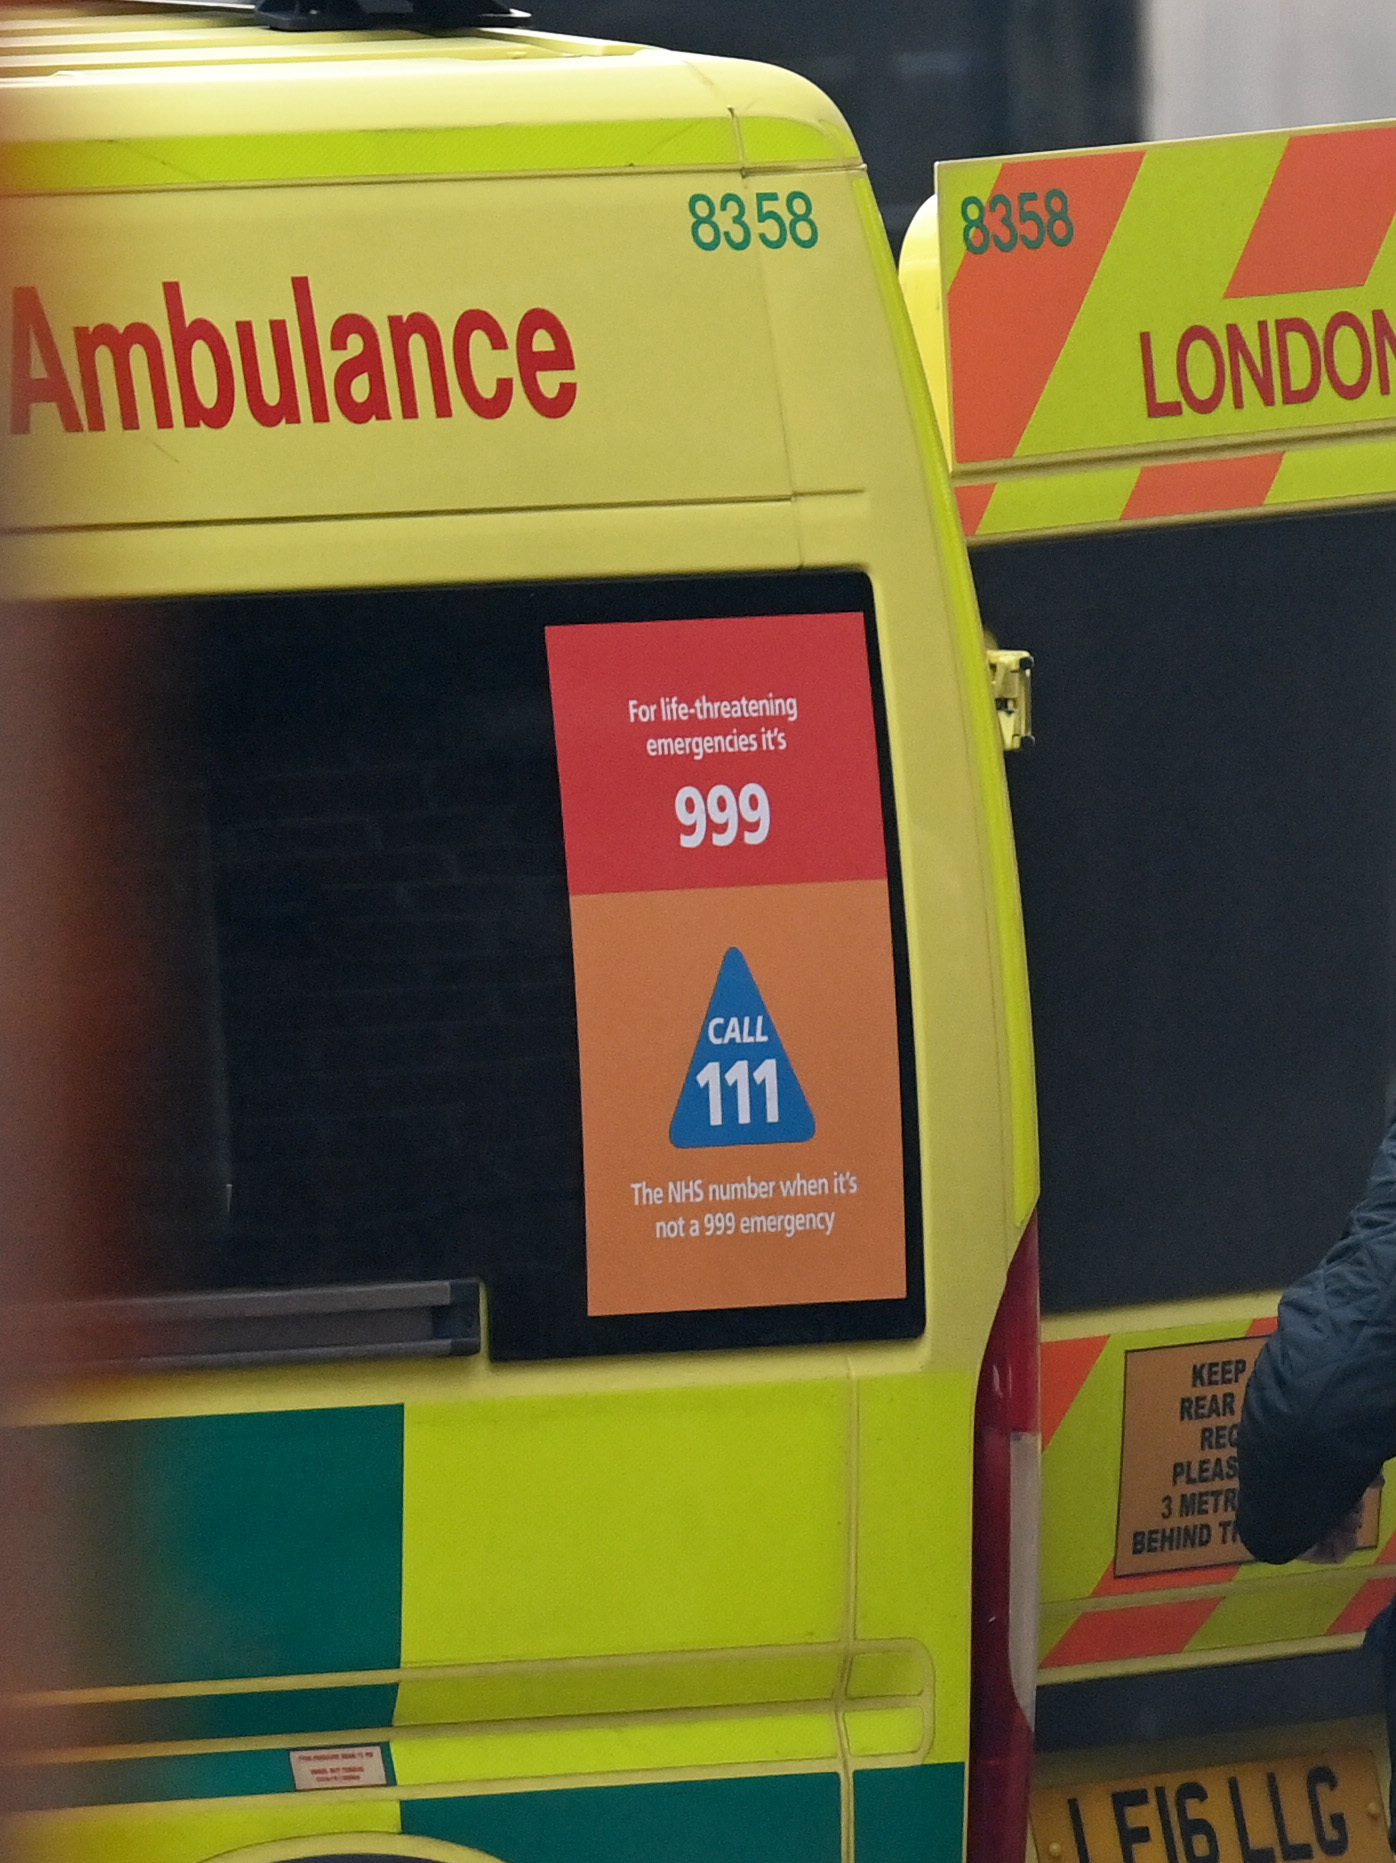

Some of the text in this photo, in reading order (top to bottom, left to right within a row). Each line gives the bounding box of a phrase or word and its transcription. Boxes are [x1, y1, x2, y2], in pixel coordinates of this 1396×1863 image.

[688, 191, 820, 251] 8358
[961, 188, 1075, 255] 8358
[10, 276, 578, 434] Ambulance
[628, 692, 798, 723] For life-threatening
[647, 727, 788, 760] emergencies it's
[675, 783, 771, 848] 999
[708, 1015, 769, 1045] CALL
[696, 1058, 780, 1126] 111
[631, 1171, 858, 1206] The NHS number when it's
[656, 1211, 836, 1239] not a 999 emergency
[1192, 1359, 1247, 1387] KEEP
[1180, 1392, 1236, 1421] REAR
[1172, 1456, 1239, 1487] PLEAS
[1161, 1488, 1238, 1519] 3 METR
[1132, 1523, 1212, 1555] BEHIND
[1228, 1766, 1349, 1863] LLG
